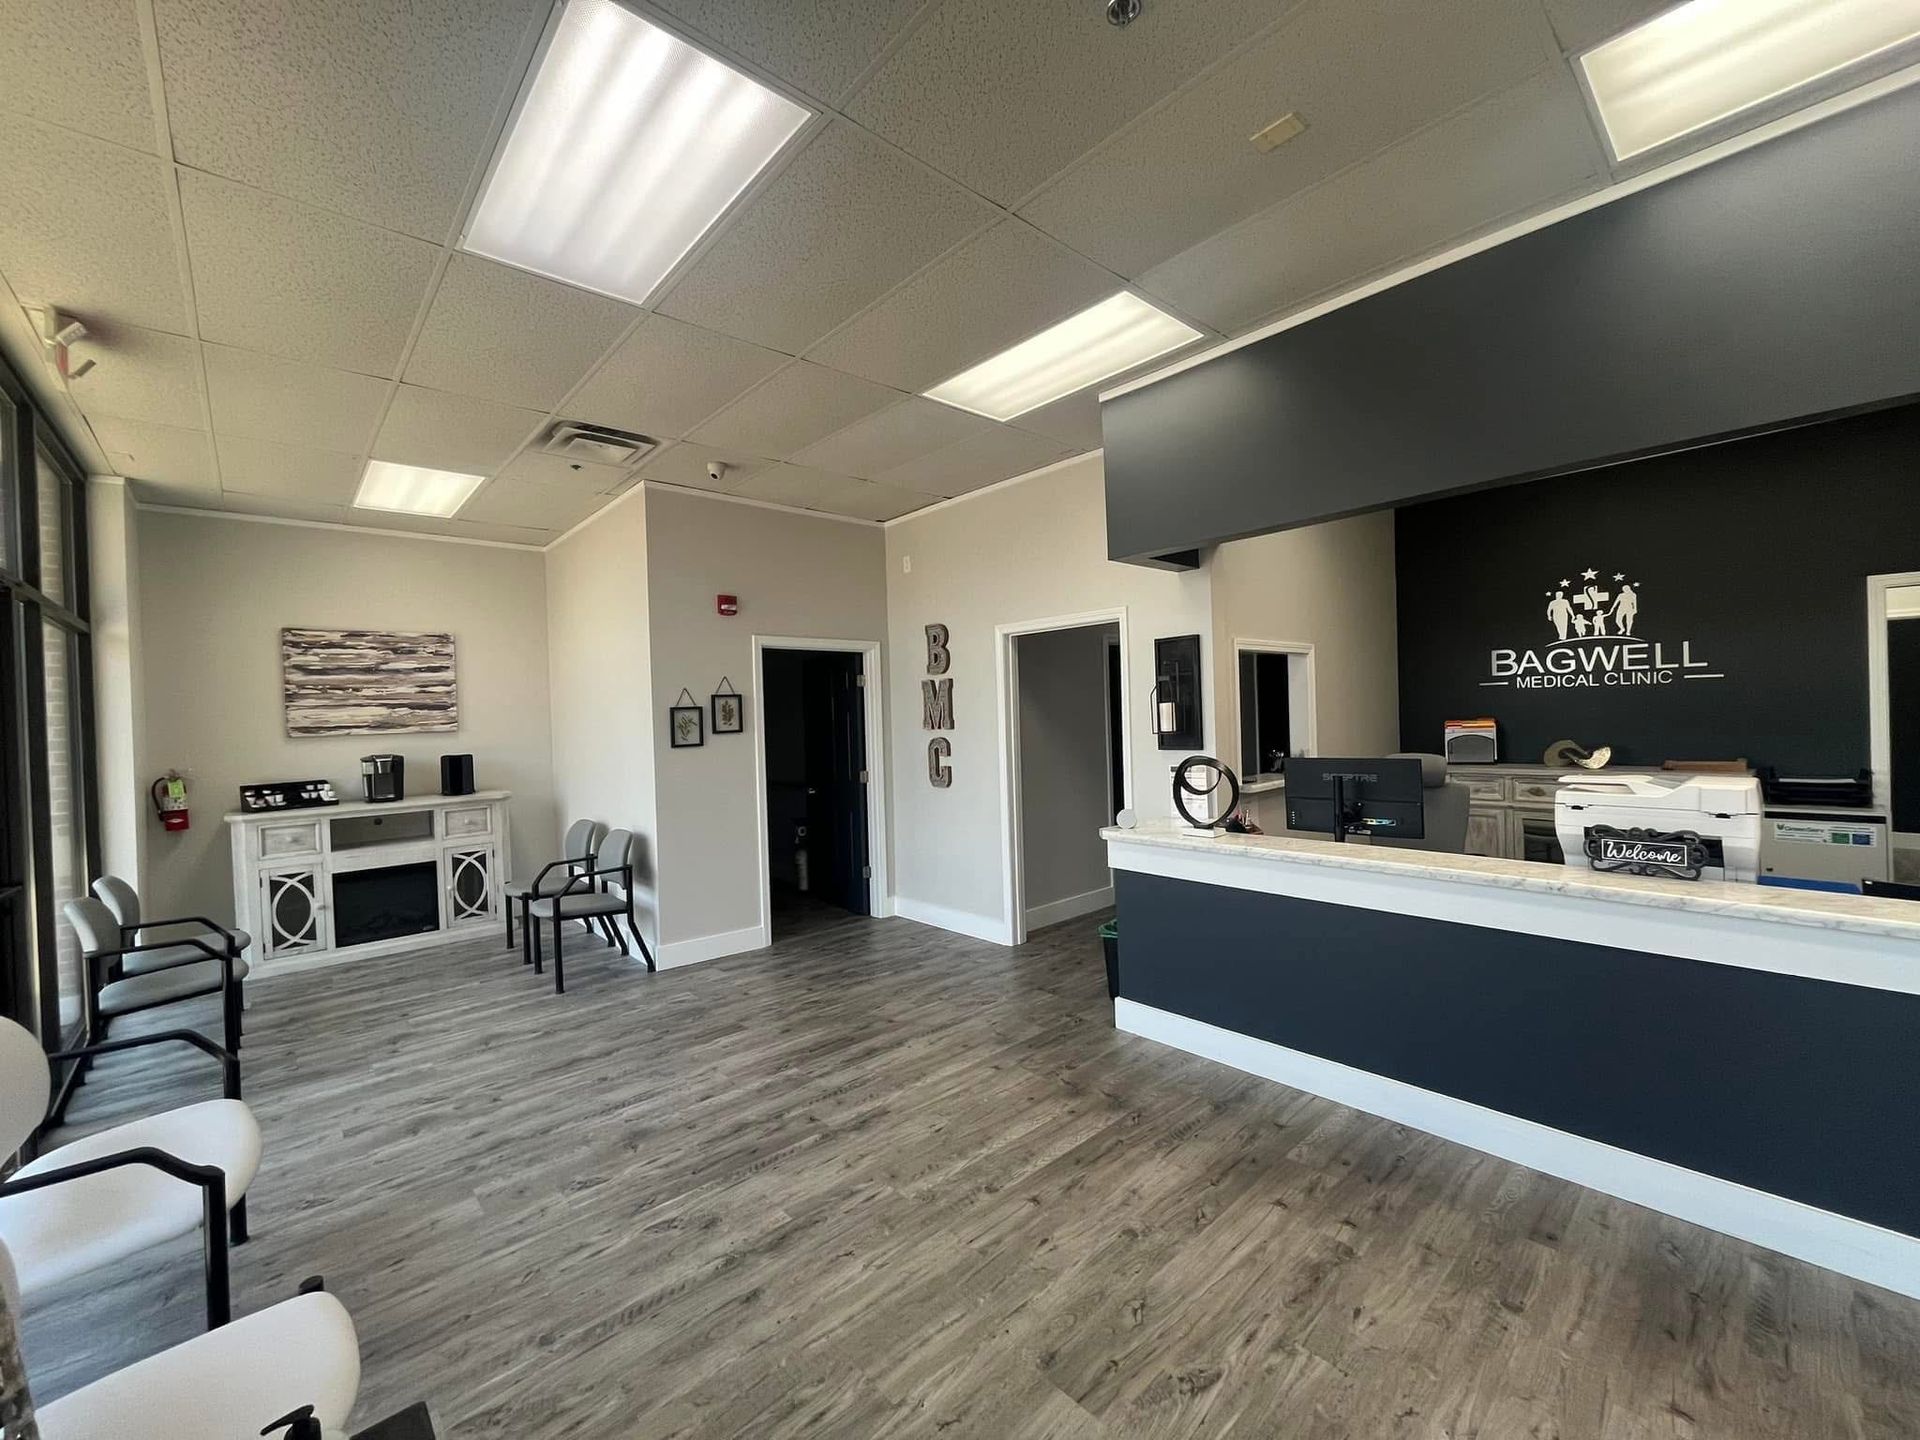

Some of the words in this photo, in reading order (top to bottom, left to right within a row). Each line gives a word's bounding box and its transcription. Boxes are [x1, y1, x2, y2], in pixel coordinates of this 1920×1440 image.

[1490, 640, 1708, 677] BAGWELL
[1516, 673, 1599, 689] MEDICAL
[1604, 670, 1673, 686] CLINIC
[1606, 841, 1682, 863] Welcome
